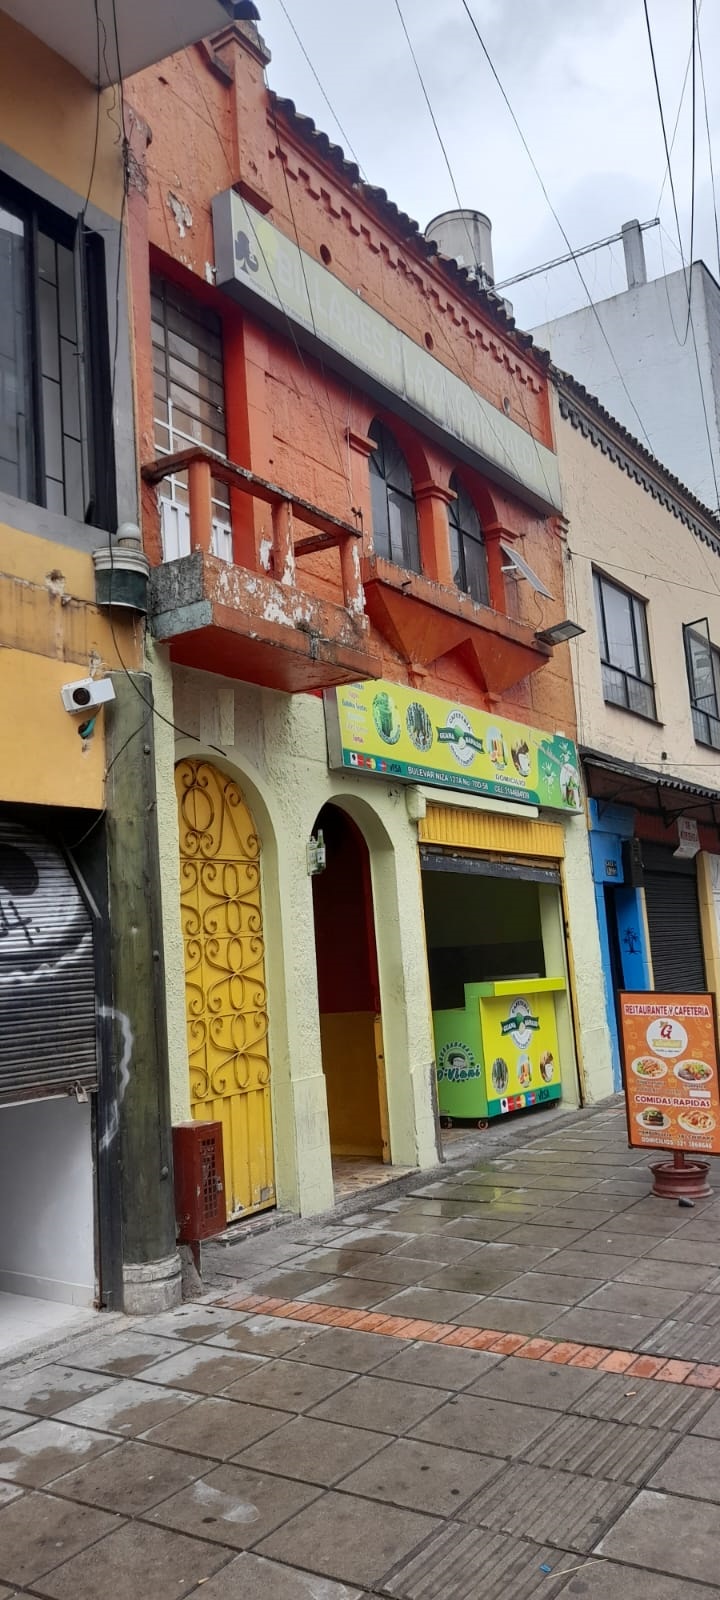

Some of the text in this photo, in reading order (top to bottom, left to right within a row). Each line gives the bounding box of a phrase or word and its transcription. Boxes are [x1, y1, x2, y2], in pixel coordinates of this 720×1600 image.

[276, 248, 385, 362] BILLARES
[408, 766, 435, 779] BULEVAR
[435, 773, 448, 782] NIZA
[625, 1005, 667, 1015] RESTAURANTE
[674, 1006, 709, 1016] CAFETERIA
[635, 1095, 710, 1107] COMIDAS RAPIDAS
